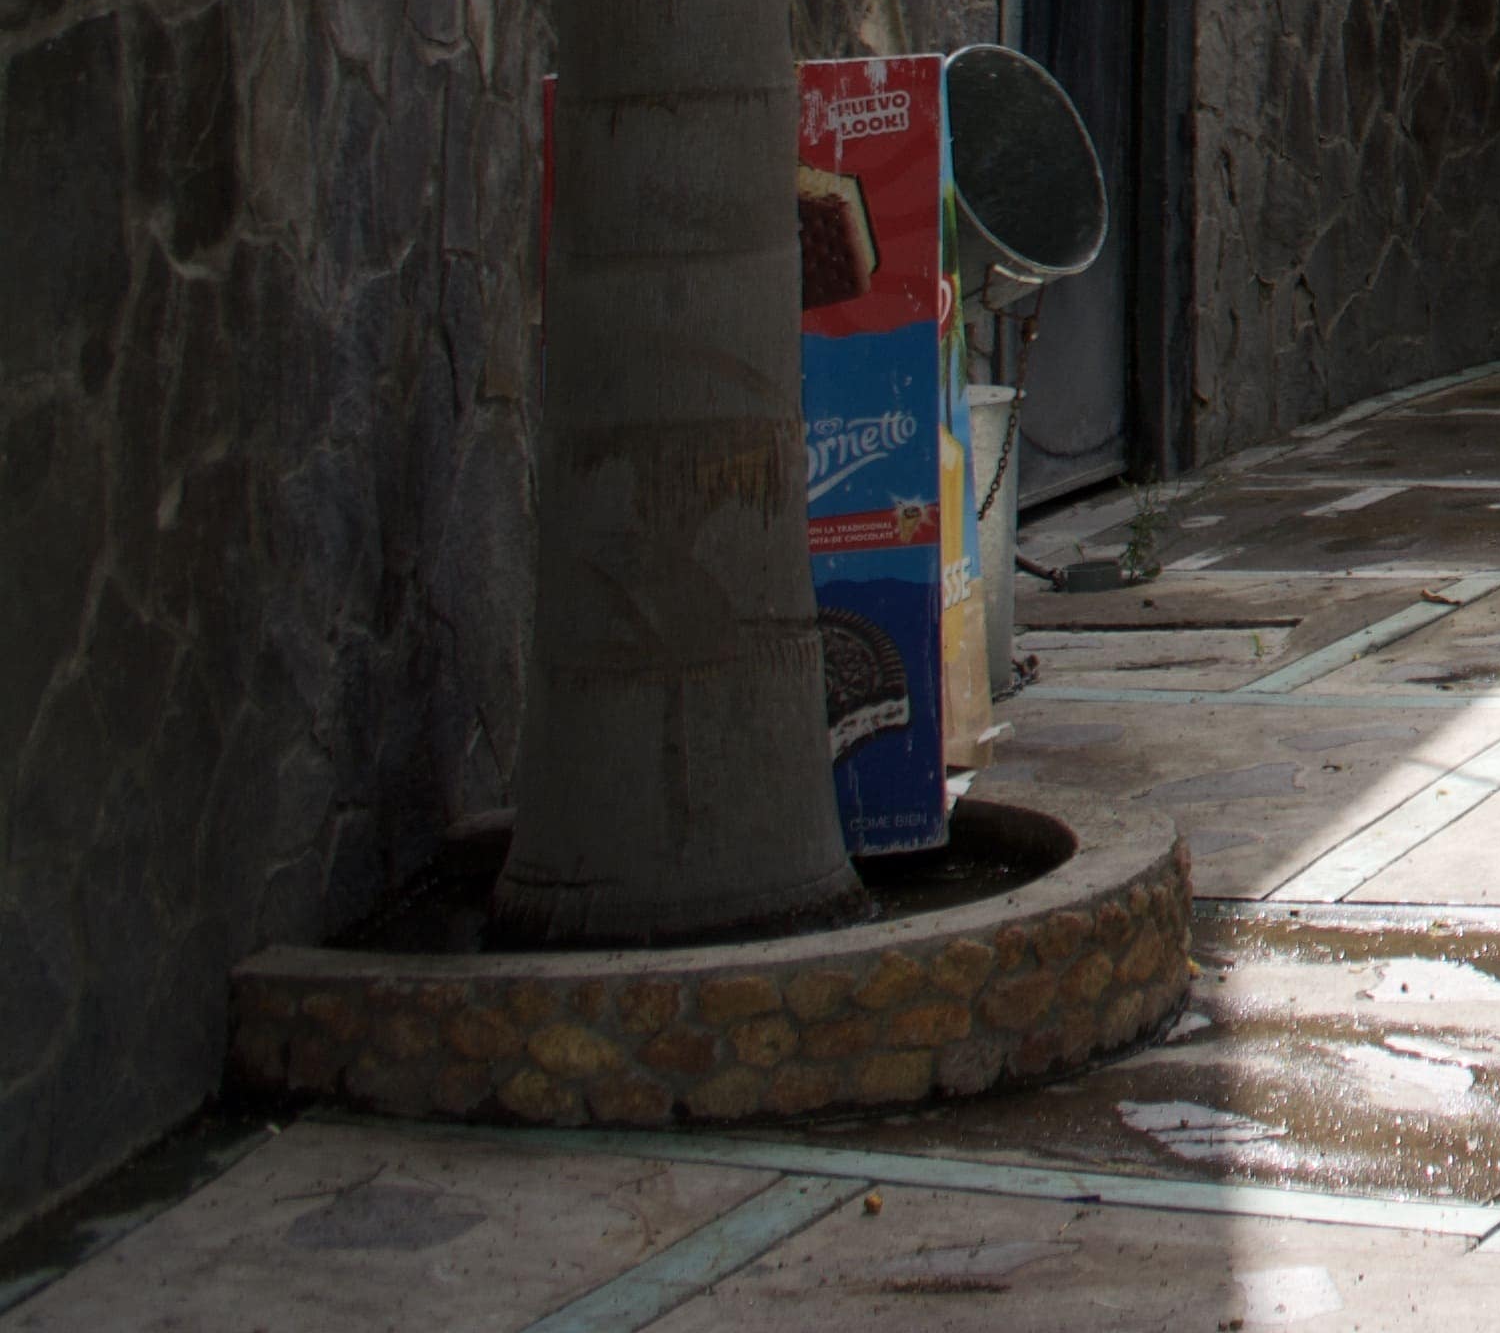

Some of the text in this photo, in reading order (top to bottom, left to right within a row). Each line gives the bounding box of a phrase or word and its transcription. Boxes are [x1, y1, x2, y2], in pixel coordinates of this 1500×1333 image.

[841, 113, 905, 136] LOOK!
[824, 525, 835, 534] LA
[837, 521, 893, 533] TRADICIONAL
[844, 531, 894, 542] CHOCOLATE
[895, 811, 928, 828] BIEN
